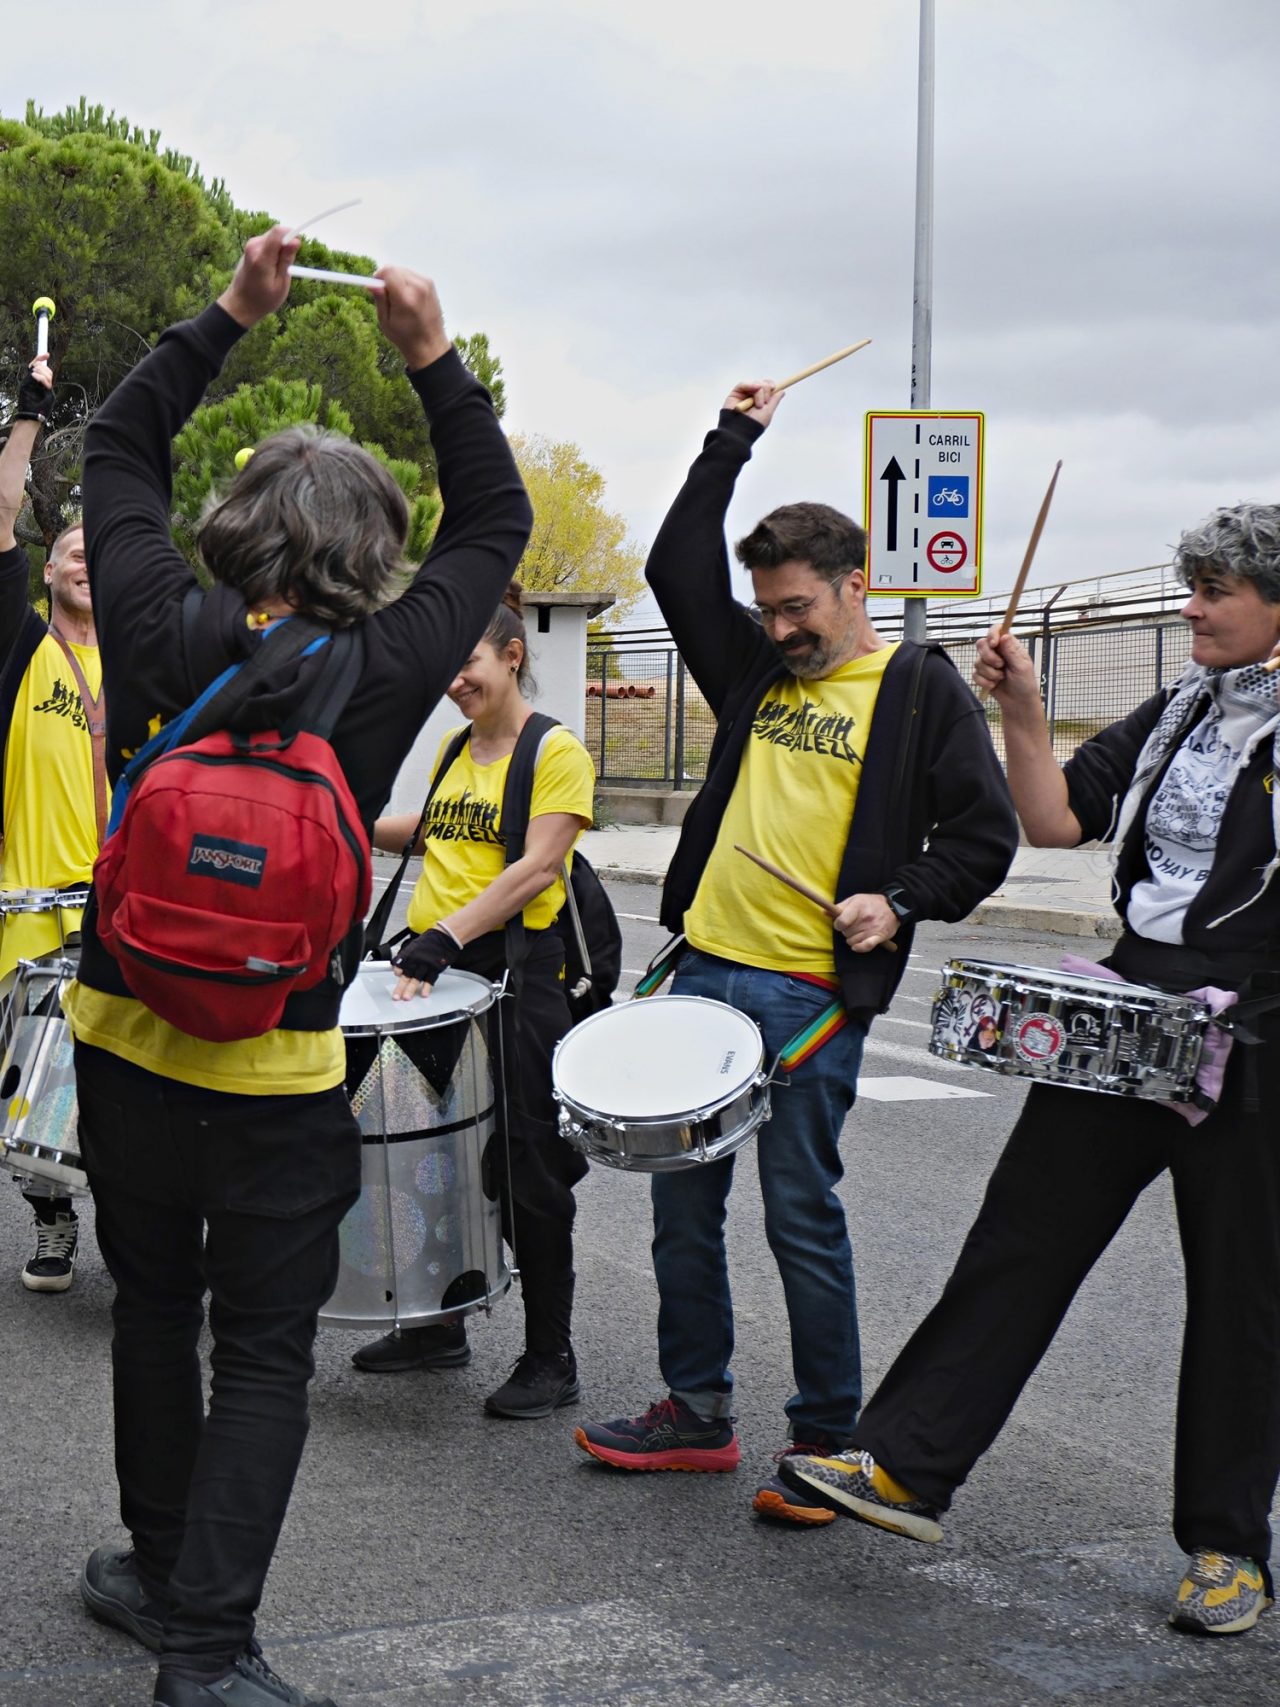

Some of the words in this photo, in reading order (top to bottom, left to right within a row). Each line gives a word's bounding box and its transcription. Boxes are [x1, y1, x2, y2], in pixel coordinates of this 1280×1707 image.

[928, 434, 970, 447] CARRIL
[938, 451, 961, 463] BICI
[190, 847, 262, 874] JANSPORT
[1156, 858, 1195, 879] HAY
[1193, 869, 1211, 881] B
[720, 1051, 736, 1074] EVANS
